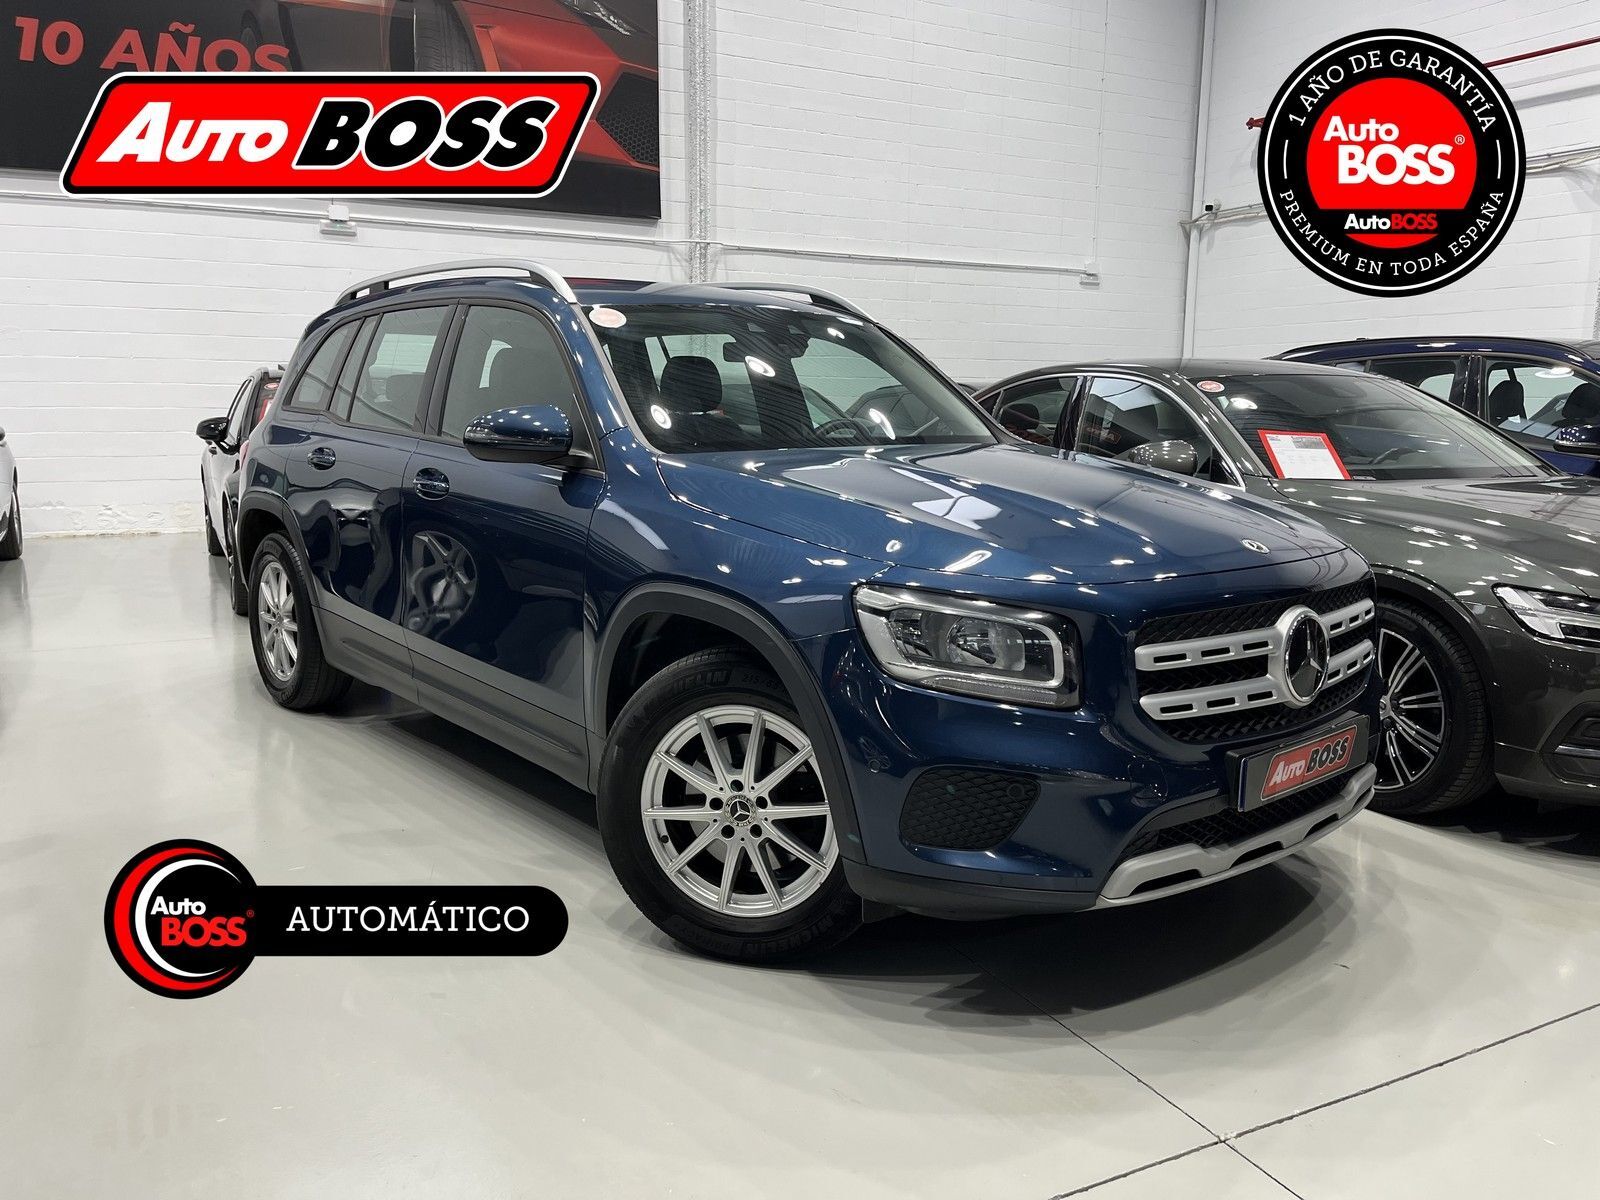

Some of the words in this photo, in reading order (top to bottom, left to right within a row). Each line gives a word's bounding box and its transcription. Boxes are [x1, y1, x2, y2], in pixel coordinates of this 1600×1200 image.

[15, 16, 84, 66] 10
[100, 22, 290, 72] AÑOS
[1305, 735, 1350, 775] BOSS
